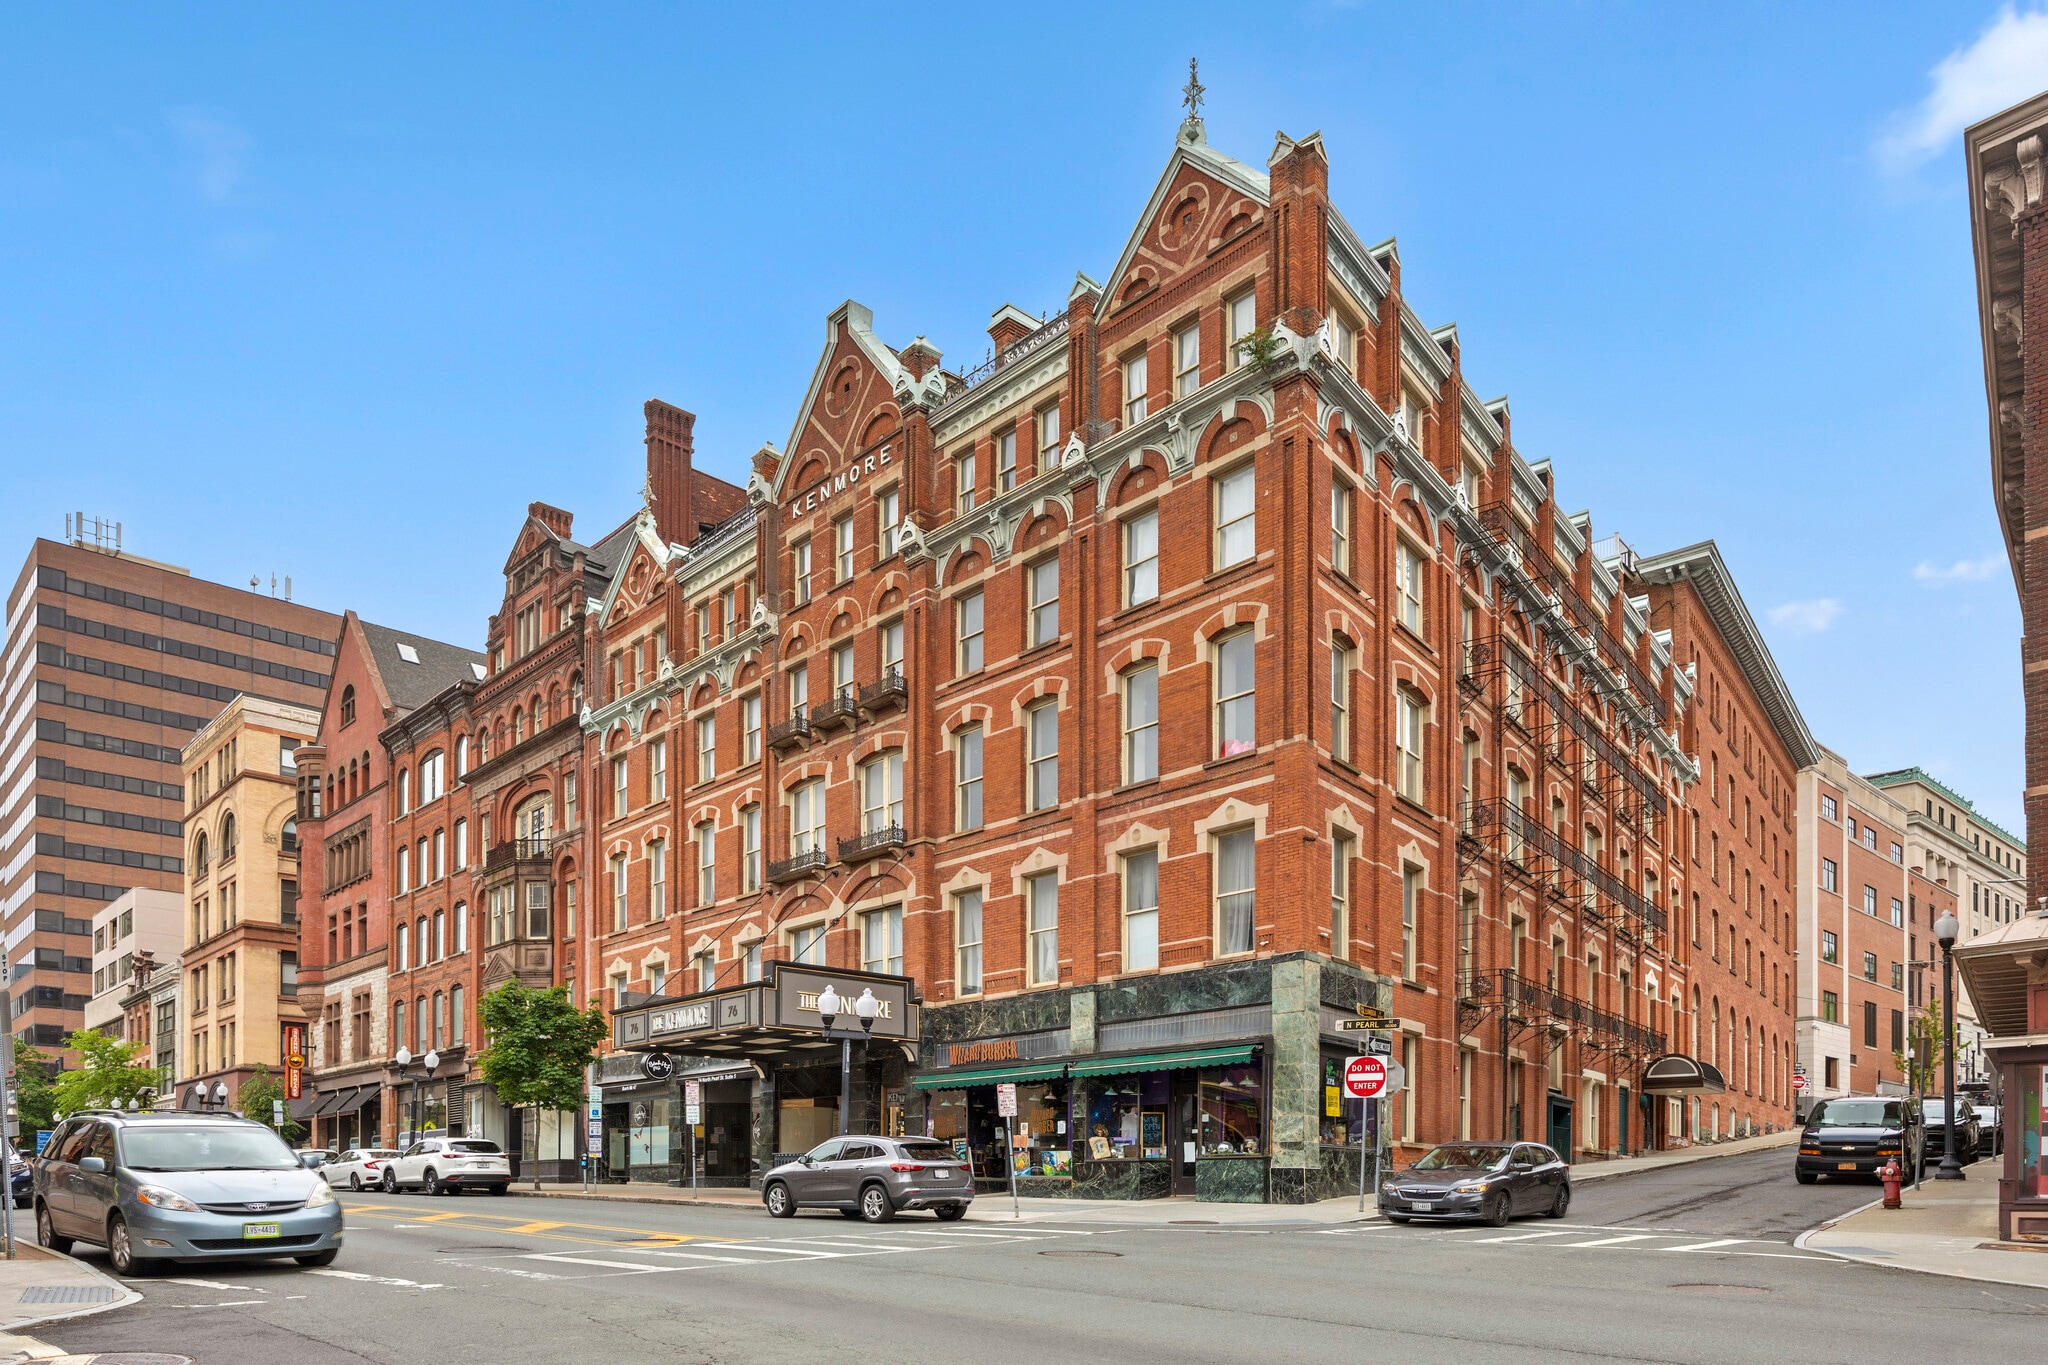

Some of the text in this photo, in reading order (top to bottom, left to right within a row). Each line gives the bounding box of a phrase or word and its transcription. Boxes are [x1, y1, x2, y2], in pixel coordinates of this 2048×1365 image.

[792, 444, 892, 519] KENMORE
[800, 993, 819, 1010] THE
[728, 1006, 738, 1018] 76
[630, 1023, 639, 1035] 76
[949, 1040, 1018, 1065] WIZARD BURGER
[1352, 1064, 1362, 1072] DO
[1353, 1082, 1377, 1090] ENTER
[1144, 1123, 1161, 1131] OPEN
